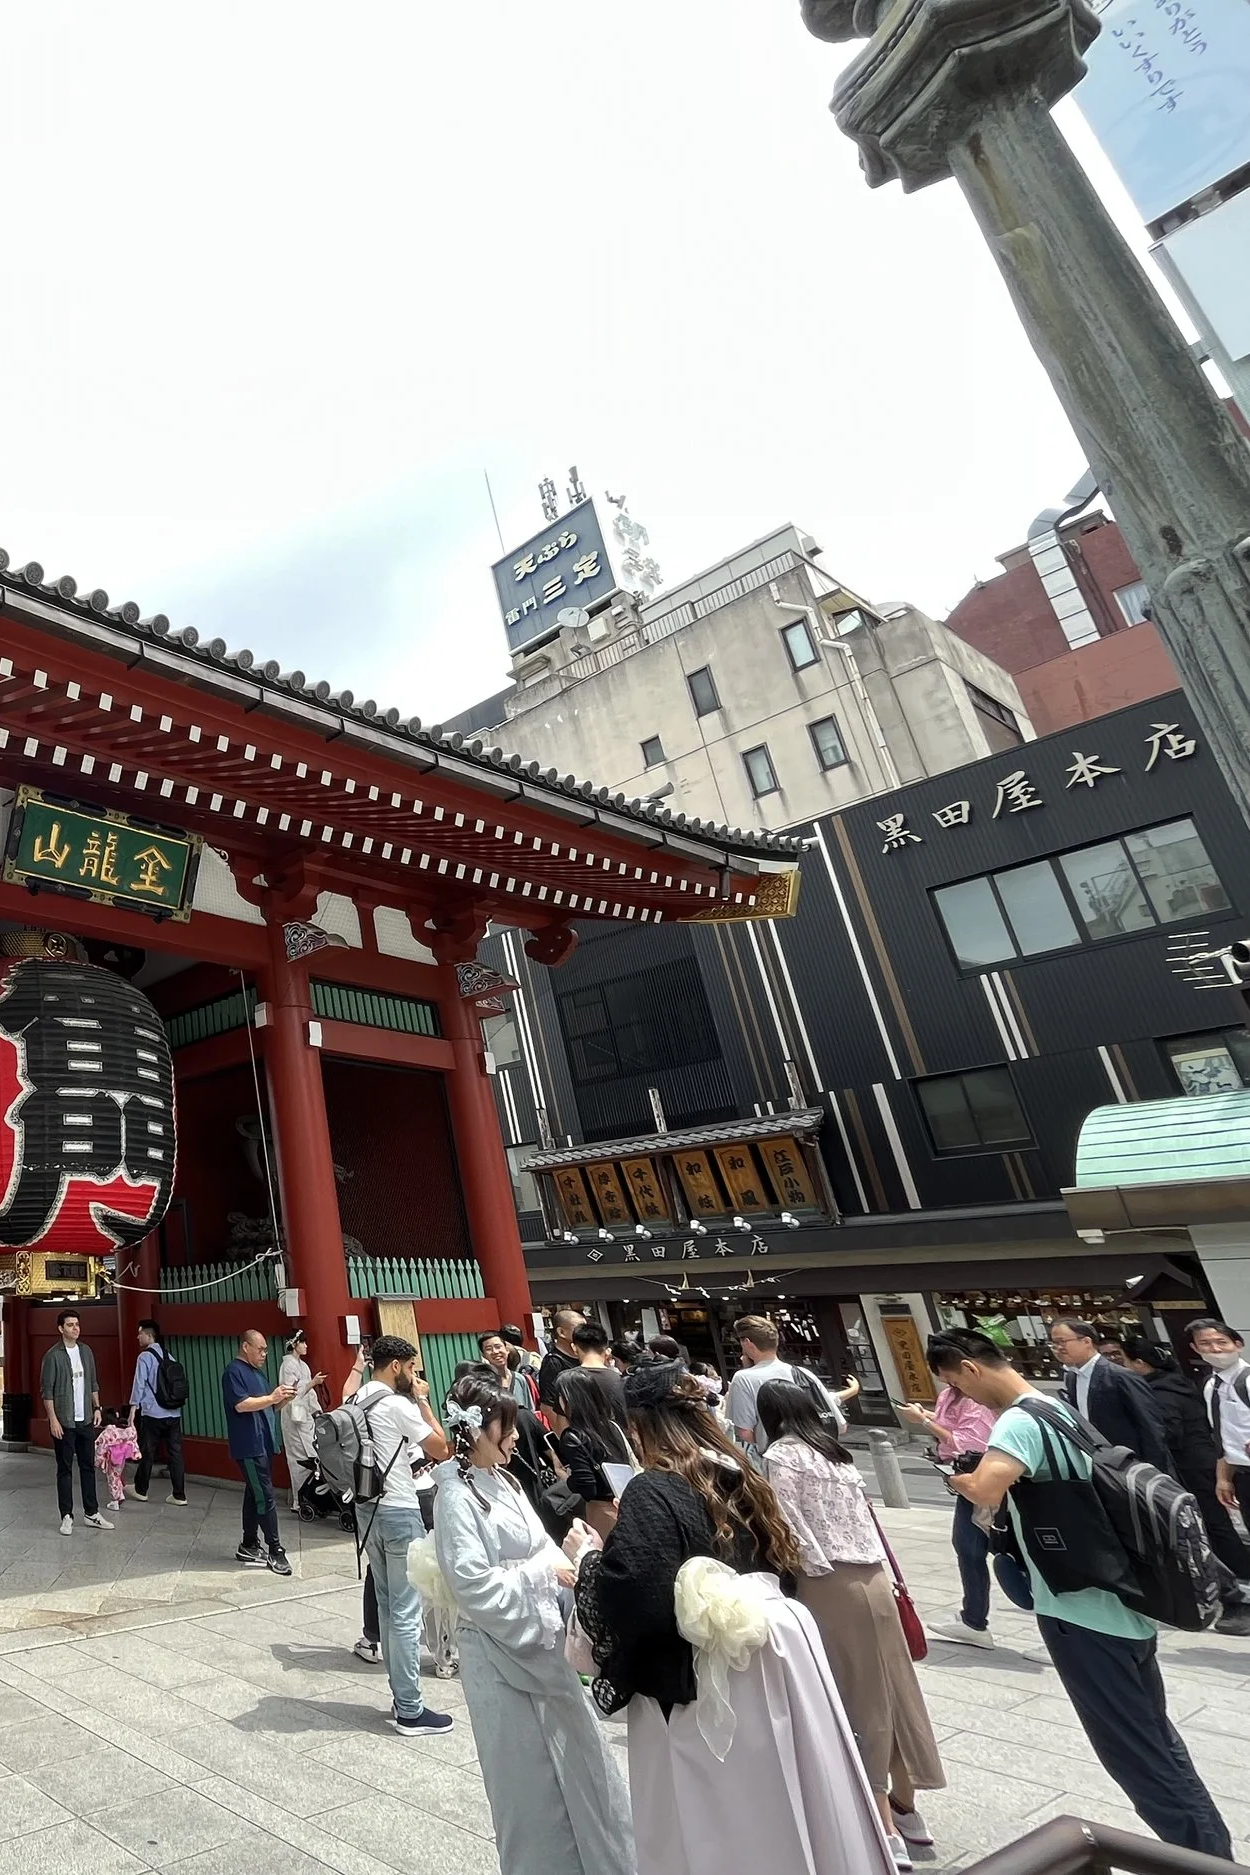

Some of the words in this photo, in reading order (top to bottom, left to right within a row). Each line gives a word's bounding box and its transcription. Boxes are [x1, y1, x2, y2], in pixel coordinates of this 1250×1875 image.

[513, 531, 578, 582] 天ぷら
[505, 595, 538, 626] 雷門
[542, 550, 602, 605] 三定
[875, 722, 1197, 855] 黒田屋本店
[686, 1161, 715, 1208] 和紙
[773, 1149, 806, 1203] 江戸小物
[622, 1234, 769, 1262] 黒田屋本店
